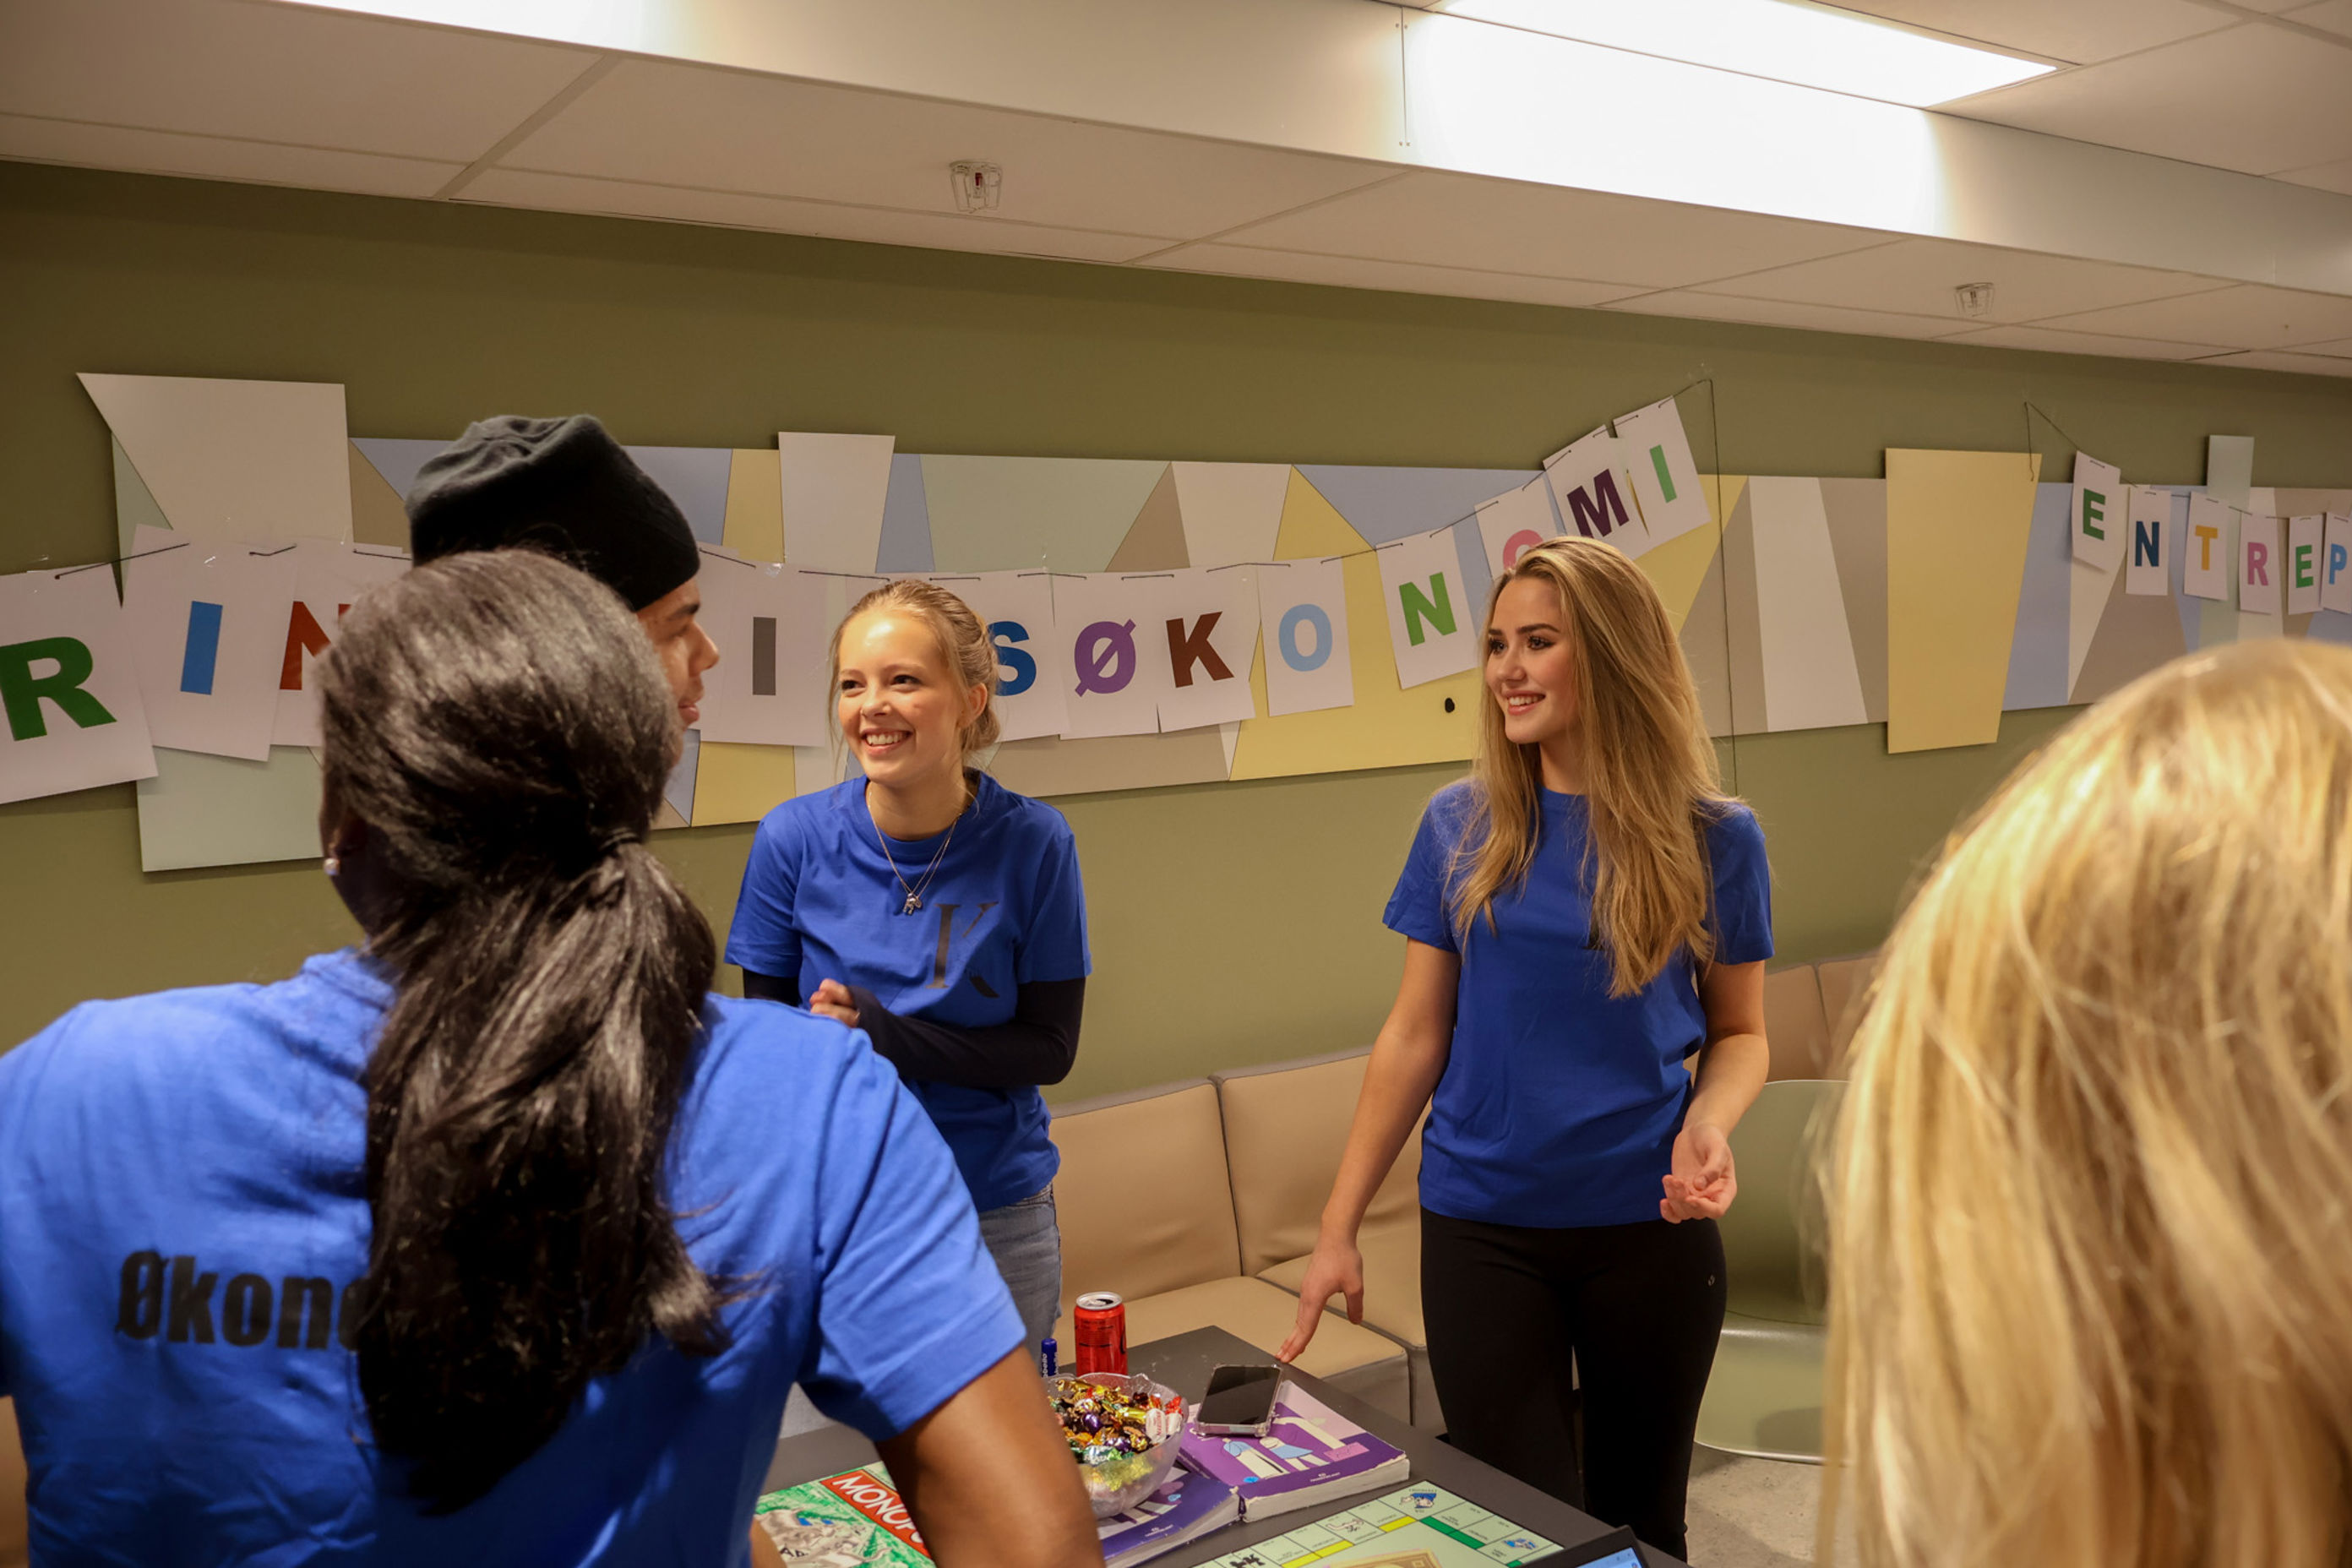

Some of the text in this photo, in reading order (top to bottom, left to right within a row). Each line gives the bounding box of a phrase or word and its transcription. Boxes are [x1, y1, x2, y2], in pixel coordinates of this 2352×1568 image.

[2082, 487, 2348, 589] ENTREP
[925, 901, 1000, 999] K
[832, 1475, 923, 1544] MONO
